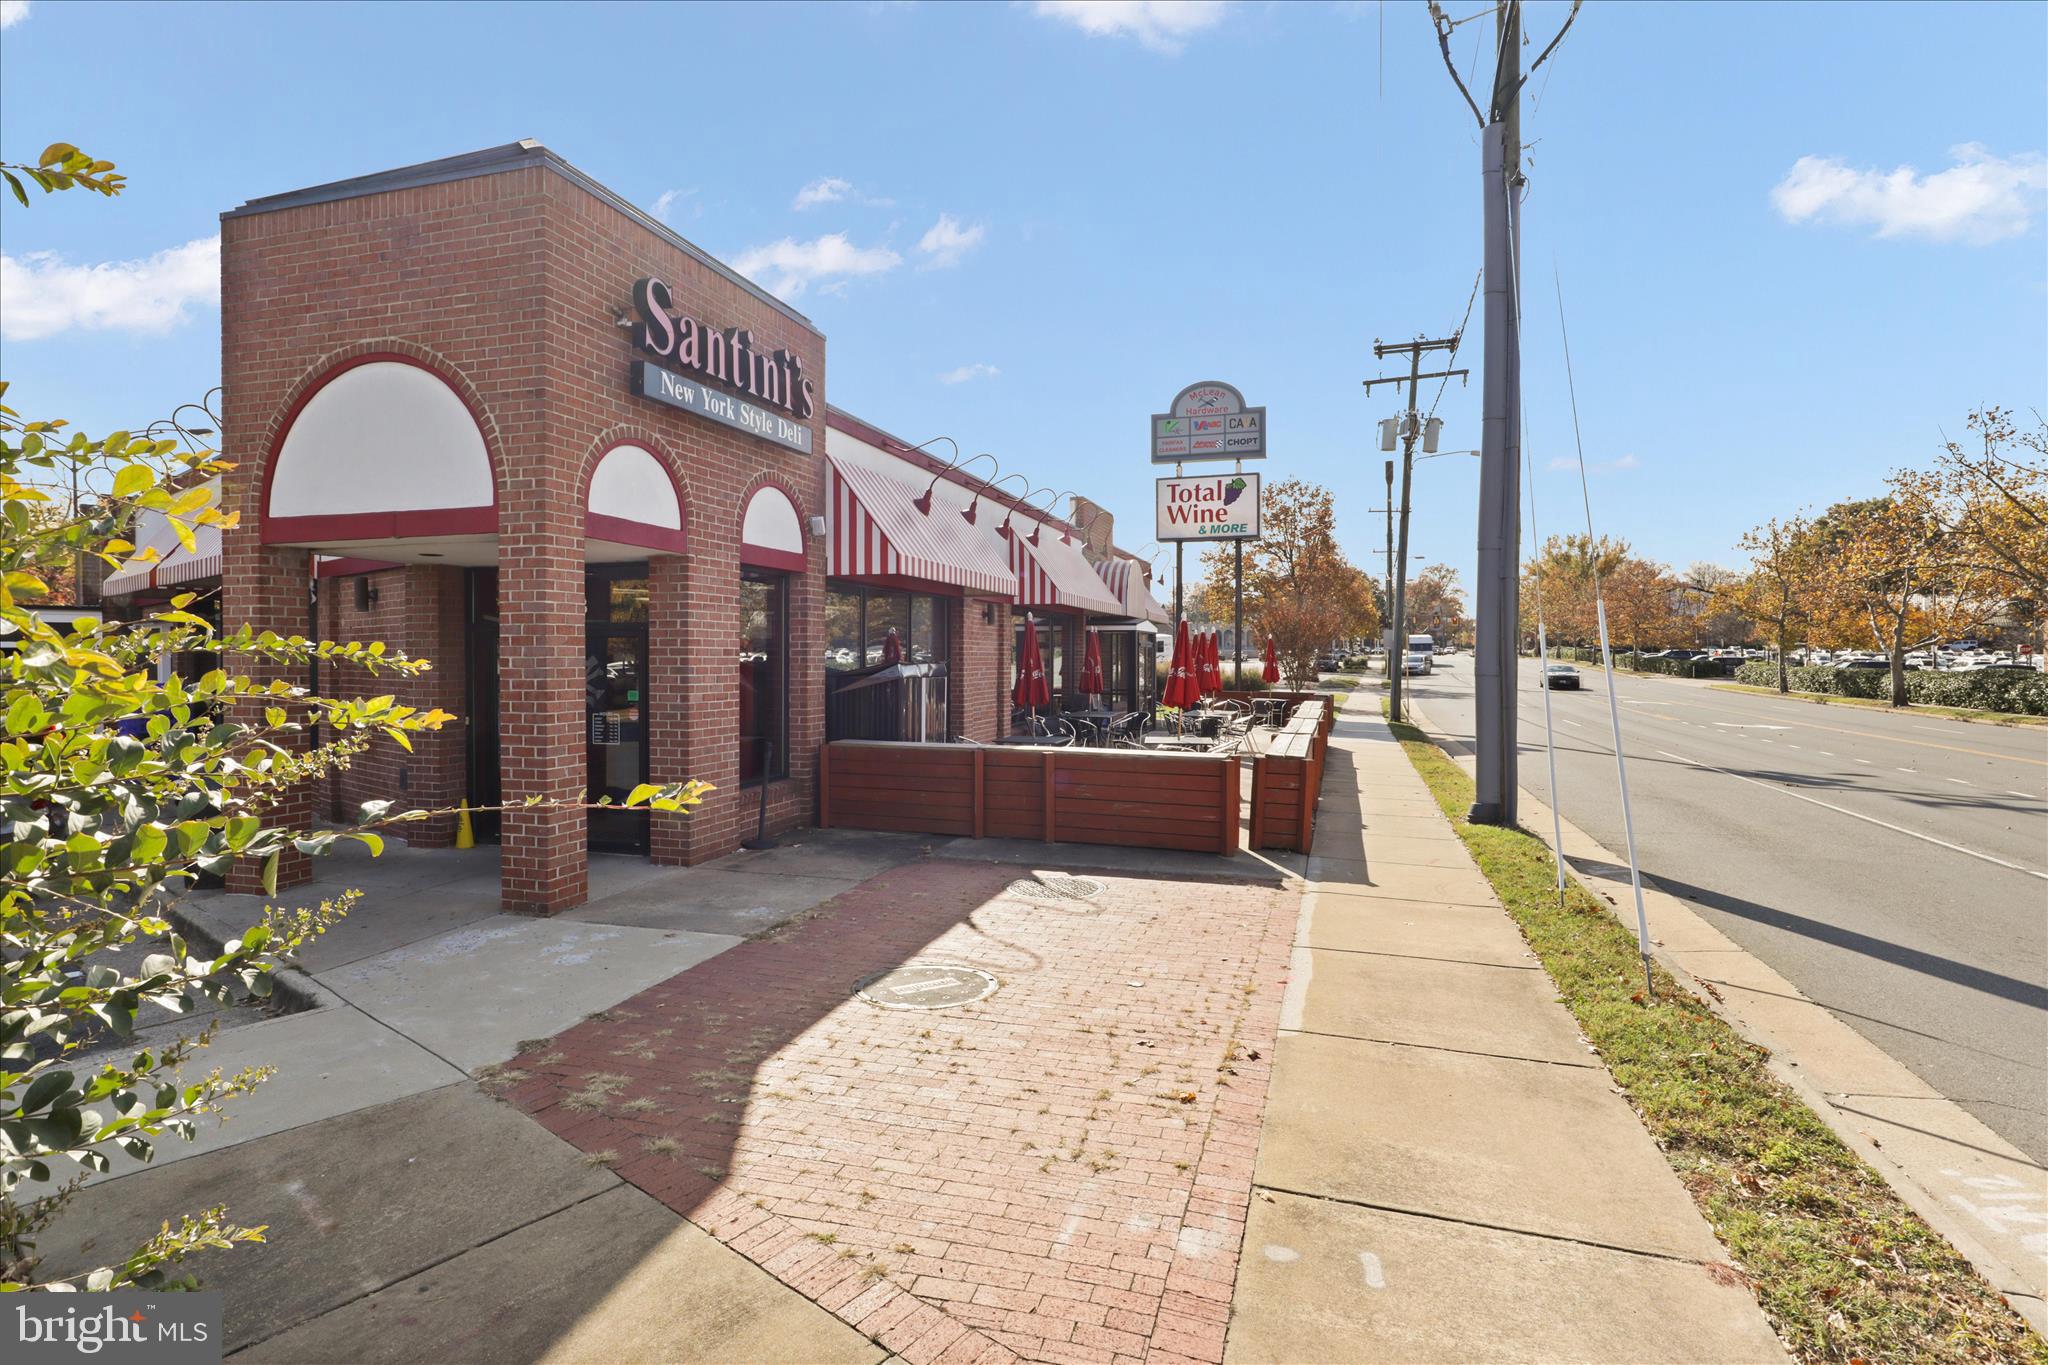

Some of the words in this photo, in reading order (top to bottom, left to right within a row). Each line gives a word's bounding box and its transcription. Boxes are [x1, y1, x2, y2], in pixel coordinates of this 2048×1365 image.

[642, 277, 815, 420] Santini's
[1188, 389, 1227, 401] McLean
[660, 370, 695, 404] New
[701, 386, 736, 421] York
[740, 402, 773, 434] Style
[778, 419, 802, 446] Deli
[1185, 406, 1229, 416] Hardware
[1227, 437, 1259, 446] CHOPT
[1167, 480, 1222, 503] Total
[1167, 504, 1228, 525] Wine
[1198, 525, 1207, 535] &
[1210, 523, 1248, 535] MORE
